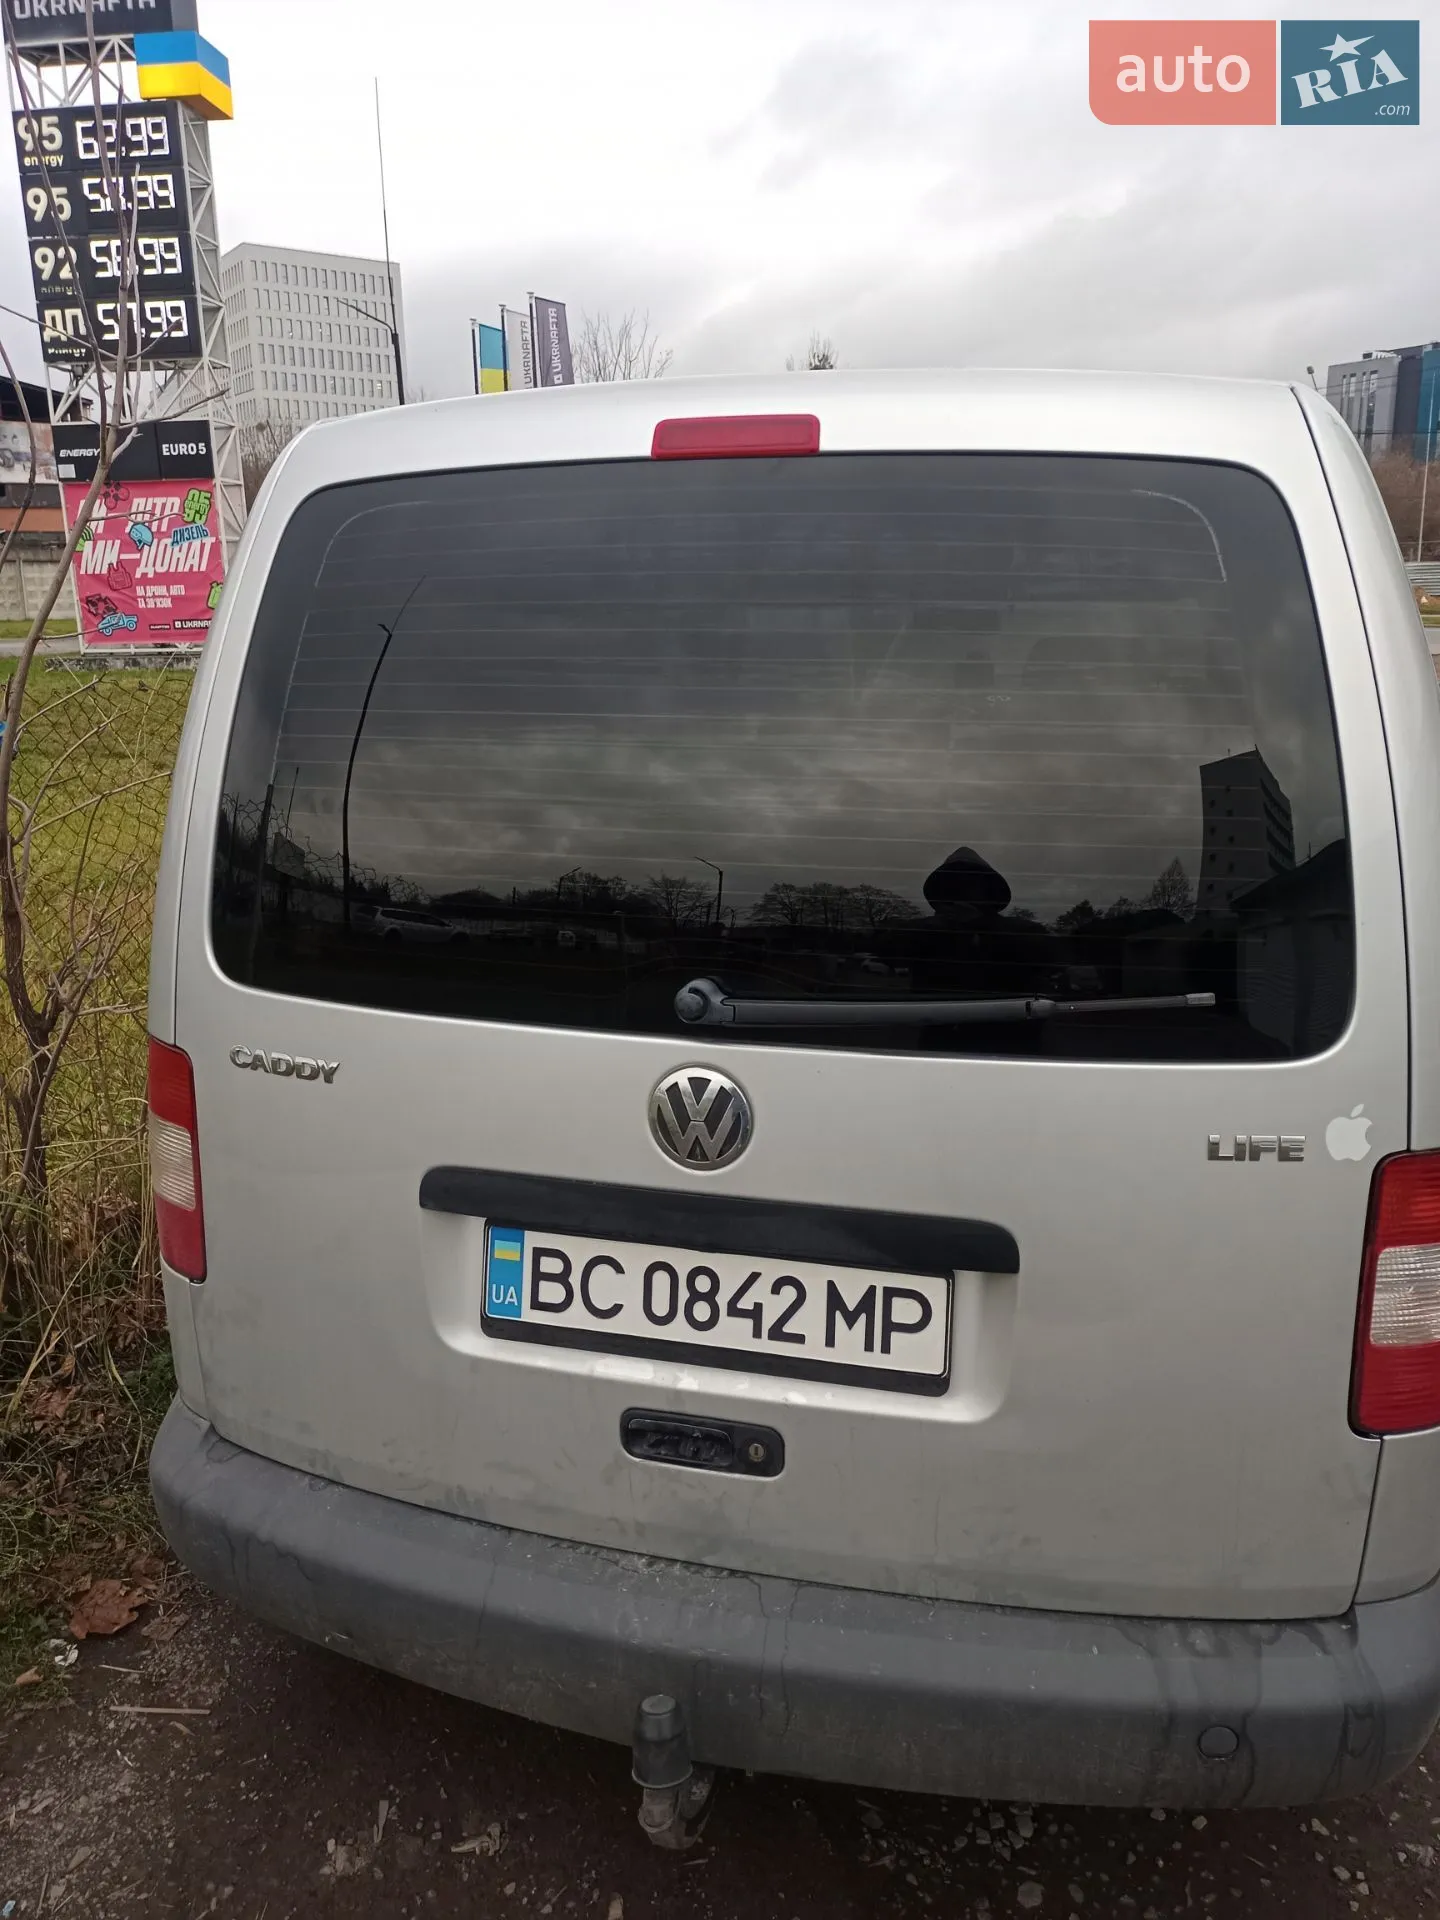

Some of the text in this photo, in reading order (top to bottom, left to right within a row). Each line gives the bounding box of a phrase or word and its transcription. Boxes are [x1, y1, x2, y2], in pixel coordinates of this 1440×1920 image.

[17, 116, 63, 152] 95
[26, 187, 72, 222] 95
[34, 246, 79, 281] 92
[43, 308, 87, 343] ДП
[548, 307, 562, 374] UKRNAFTA
[520, 320, 532, 385] UKRNAFTA
[59, 448, 100, 457] ENERGY
[162, 443, 197, 456] EURO
[173, 524, 209, 545] ДИЗЕЛЬ
[229, 1045, 341, 1084] CADDY
[1207, 1134, 1306, 1162] LIFE
[491, 1283, 518, 1307] UA
[530, 1246, 933, 1355] BC 0842 MP
